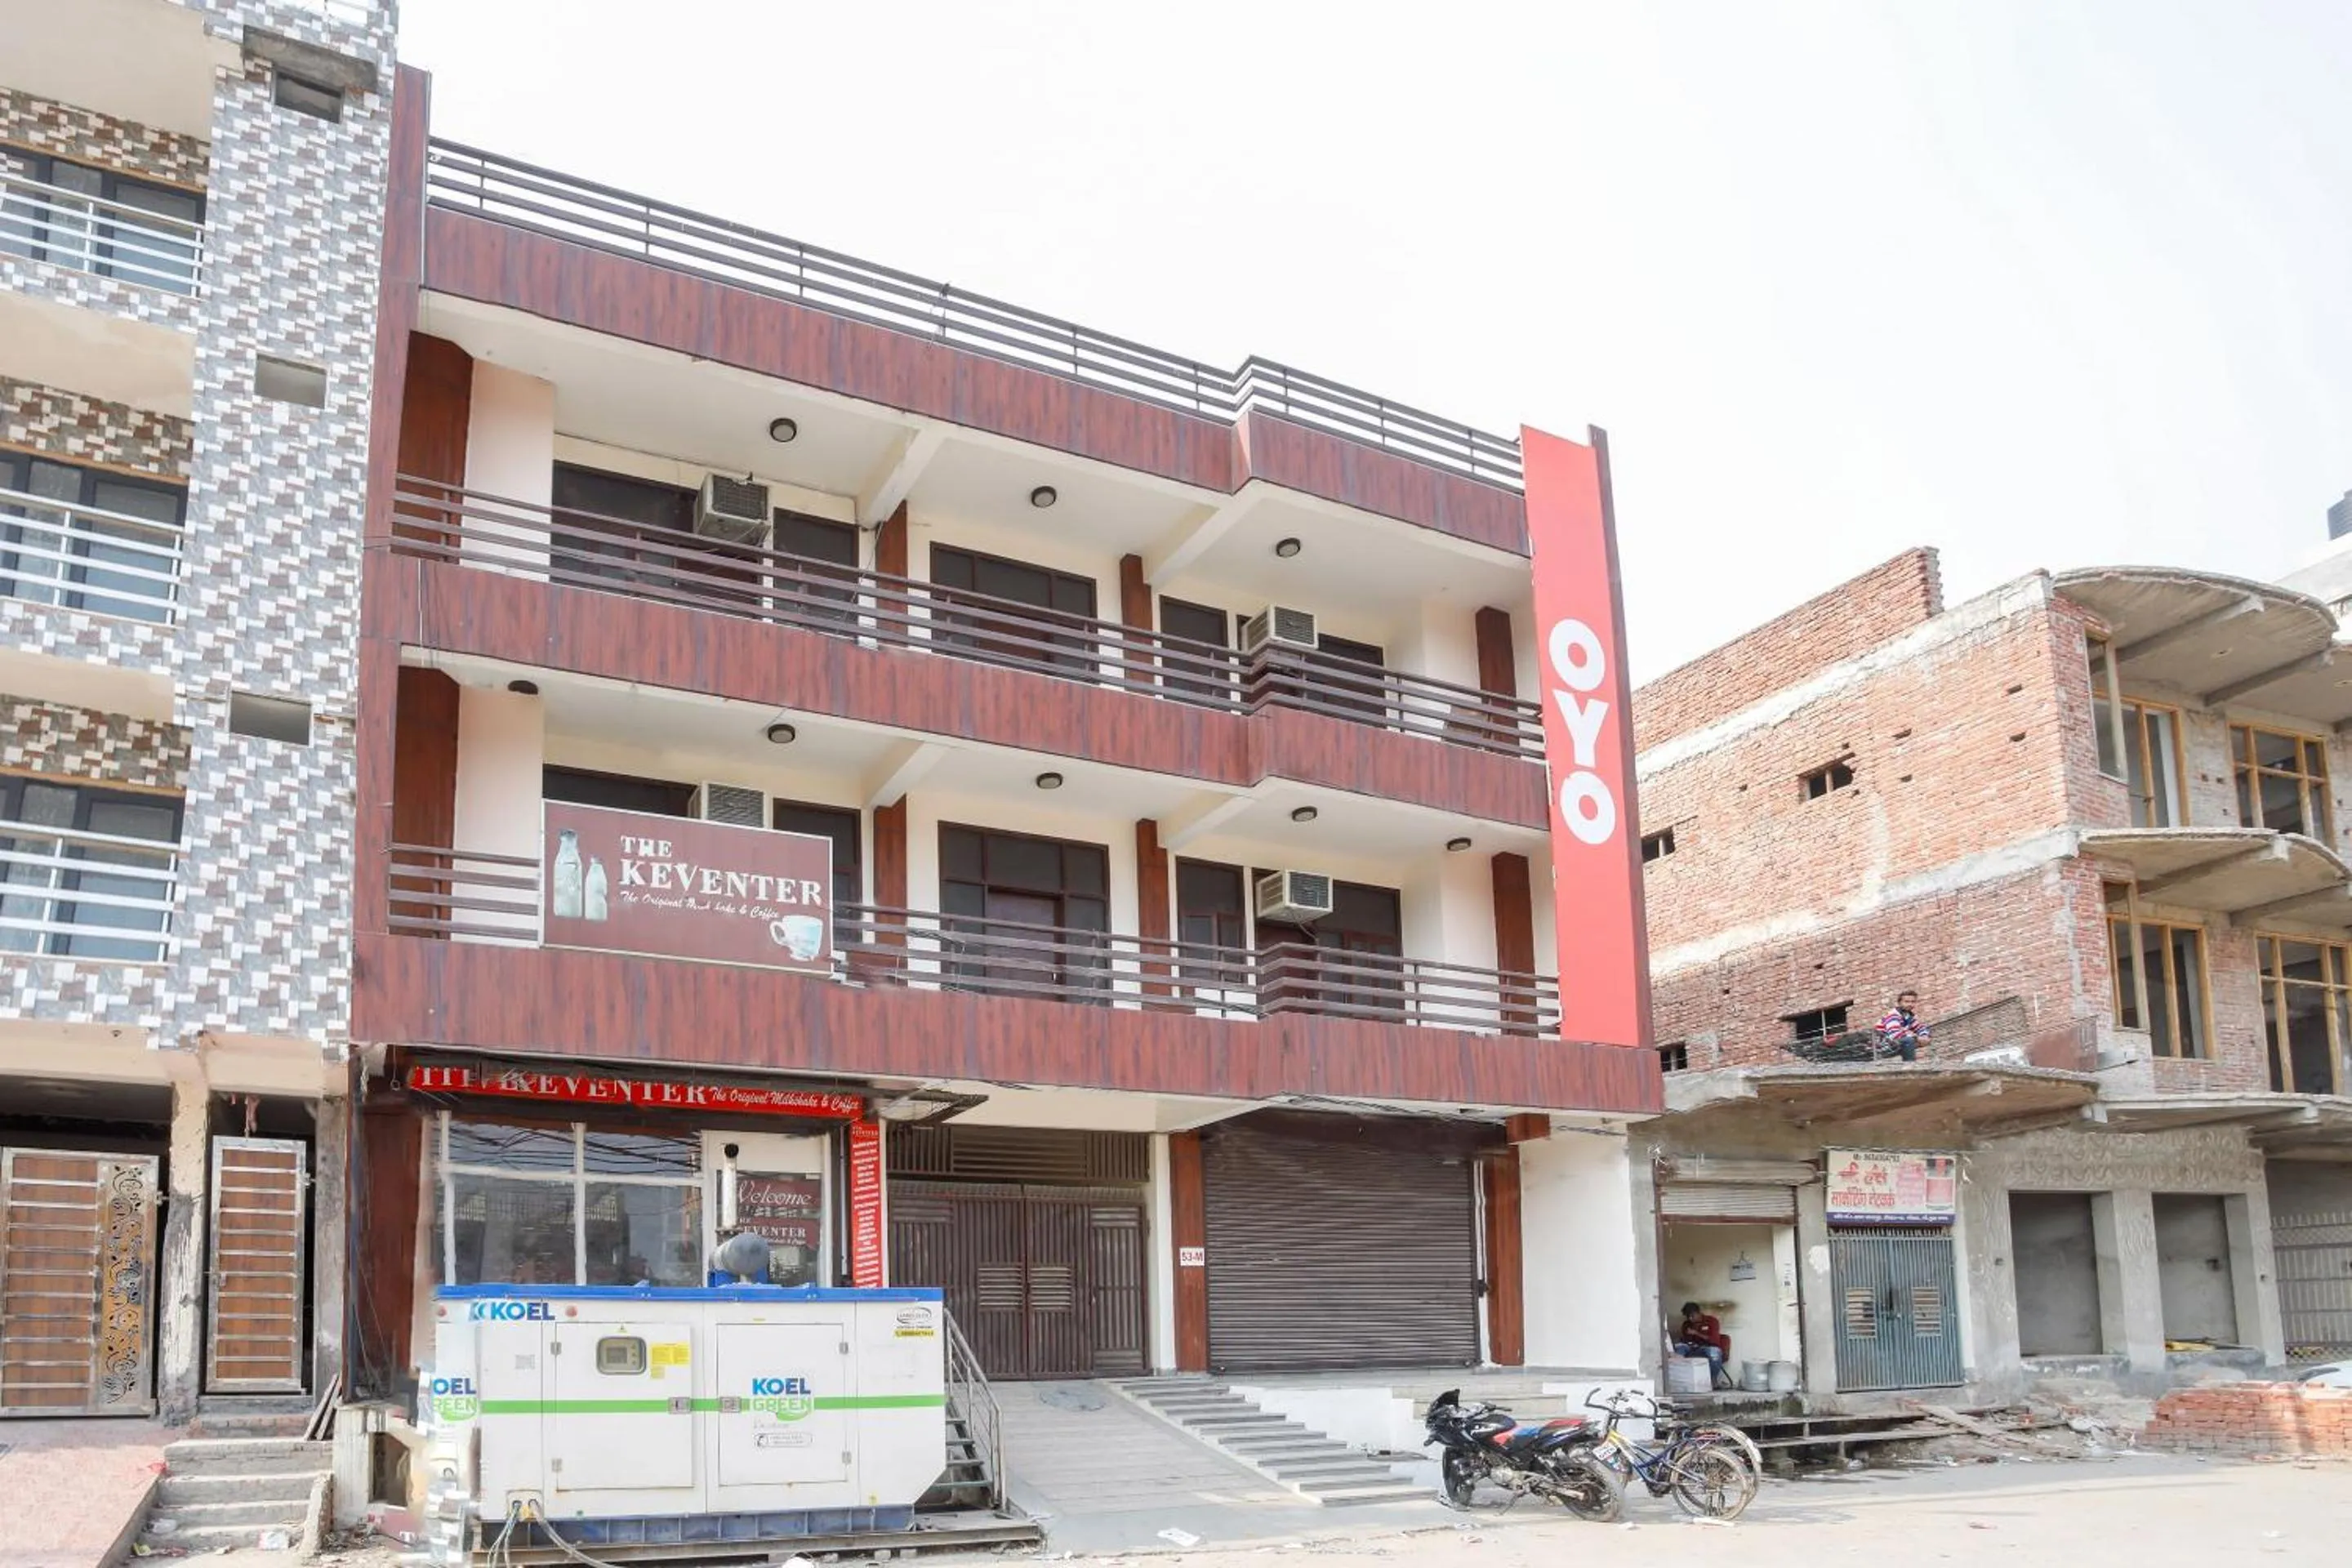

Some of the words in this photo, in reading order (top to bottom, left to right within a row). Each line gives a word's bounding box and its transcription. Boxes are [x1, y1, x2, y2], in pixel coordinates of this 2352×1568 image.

[1548, 618, 1616, 845] OYO
[620, 835, 672, 858] THE
[618, 858, 822, 906] KEVENTER
[620, 890, 638, 904] The
[709, 1086, 725, 1101] The
[729, 1089, 768, 1108] Original
[752, 1378, 811, 1396] KOEL
[753, 1397, 812, 1412] GREEN
